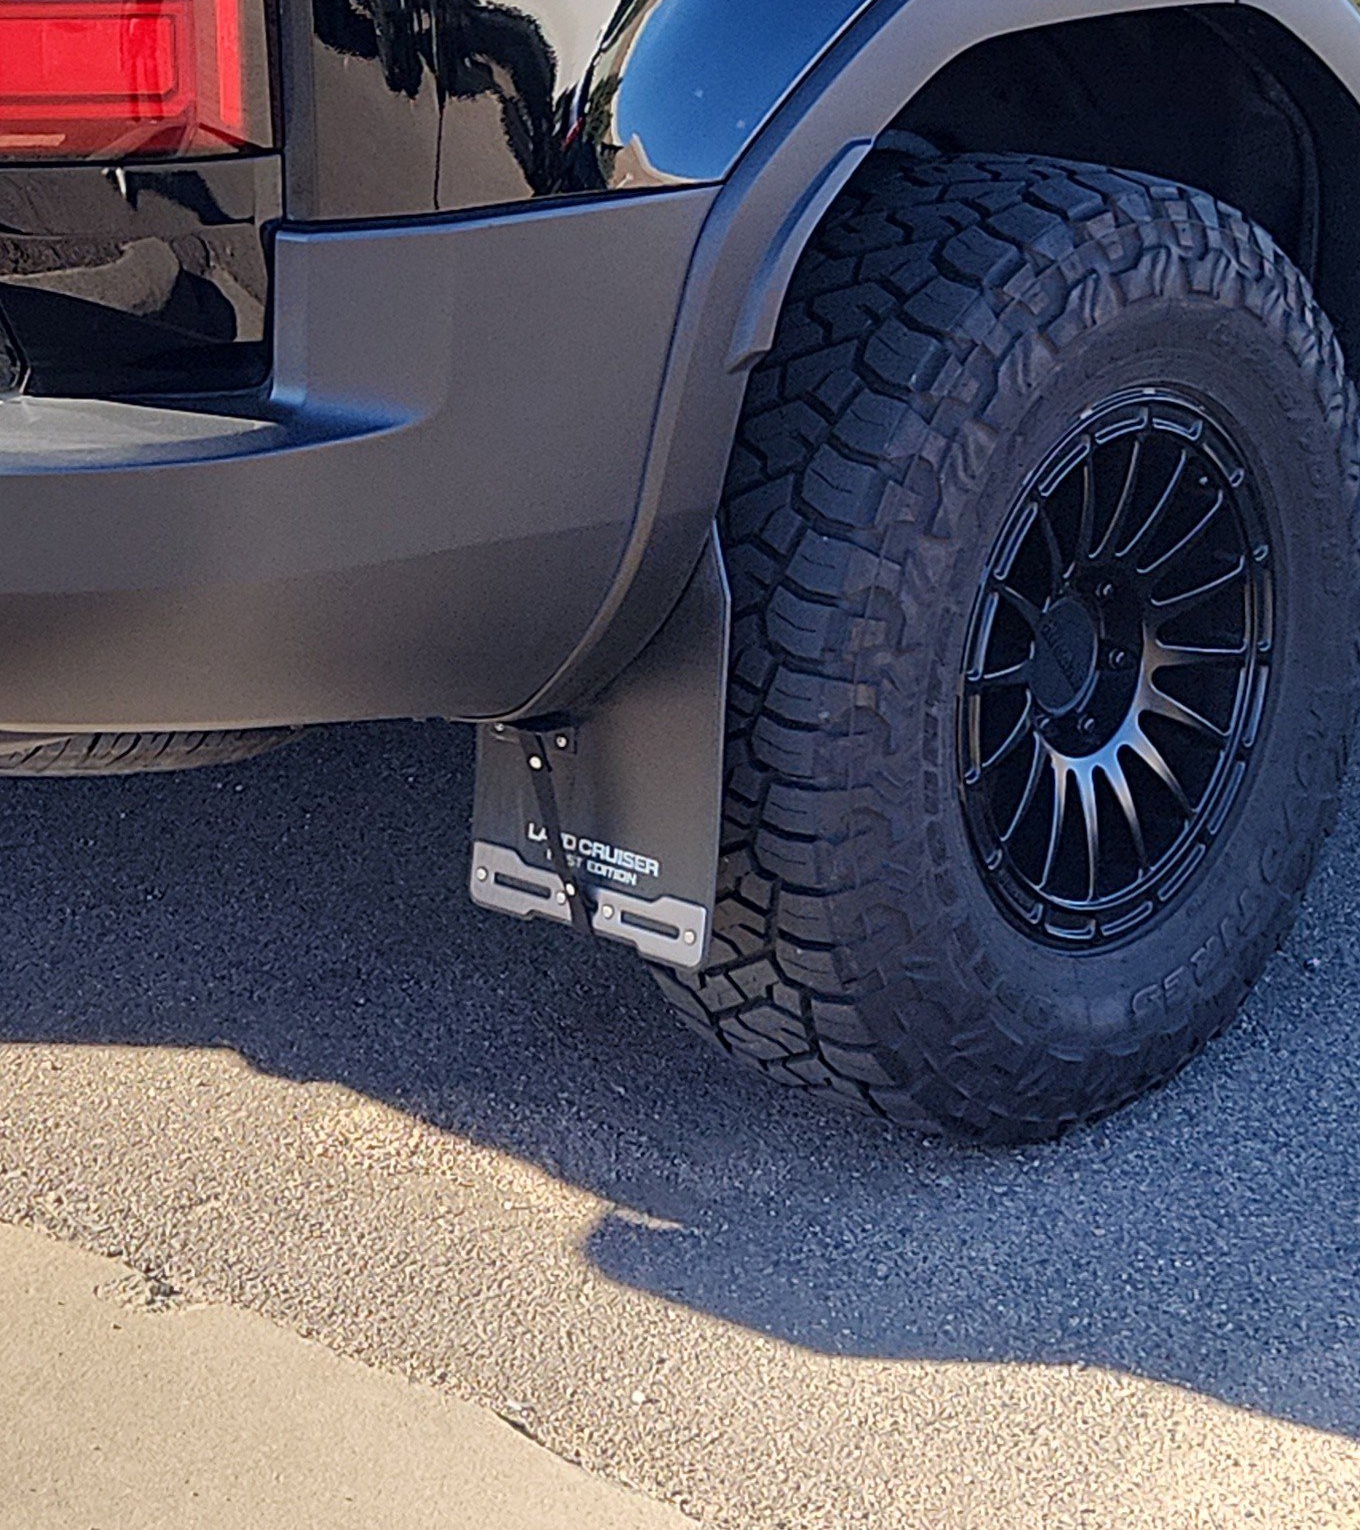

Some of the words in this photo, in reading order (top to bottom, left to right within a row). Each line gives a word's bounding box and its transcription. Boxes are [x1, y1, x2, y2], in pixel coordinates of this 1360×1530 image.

[527, 821, 577, 852] LAD
[578, 837, 660, 878] CRUISER
[586, 859, 638, 887] EDITION
